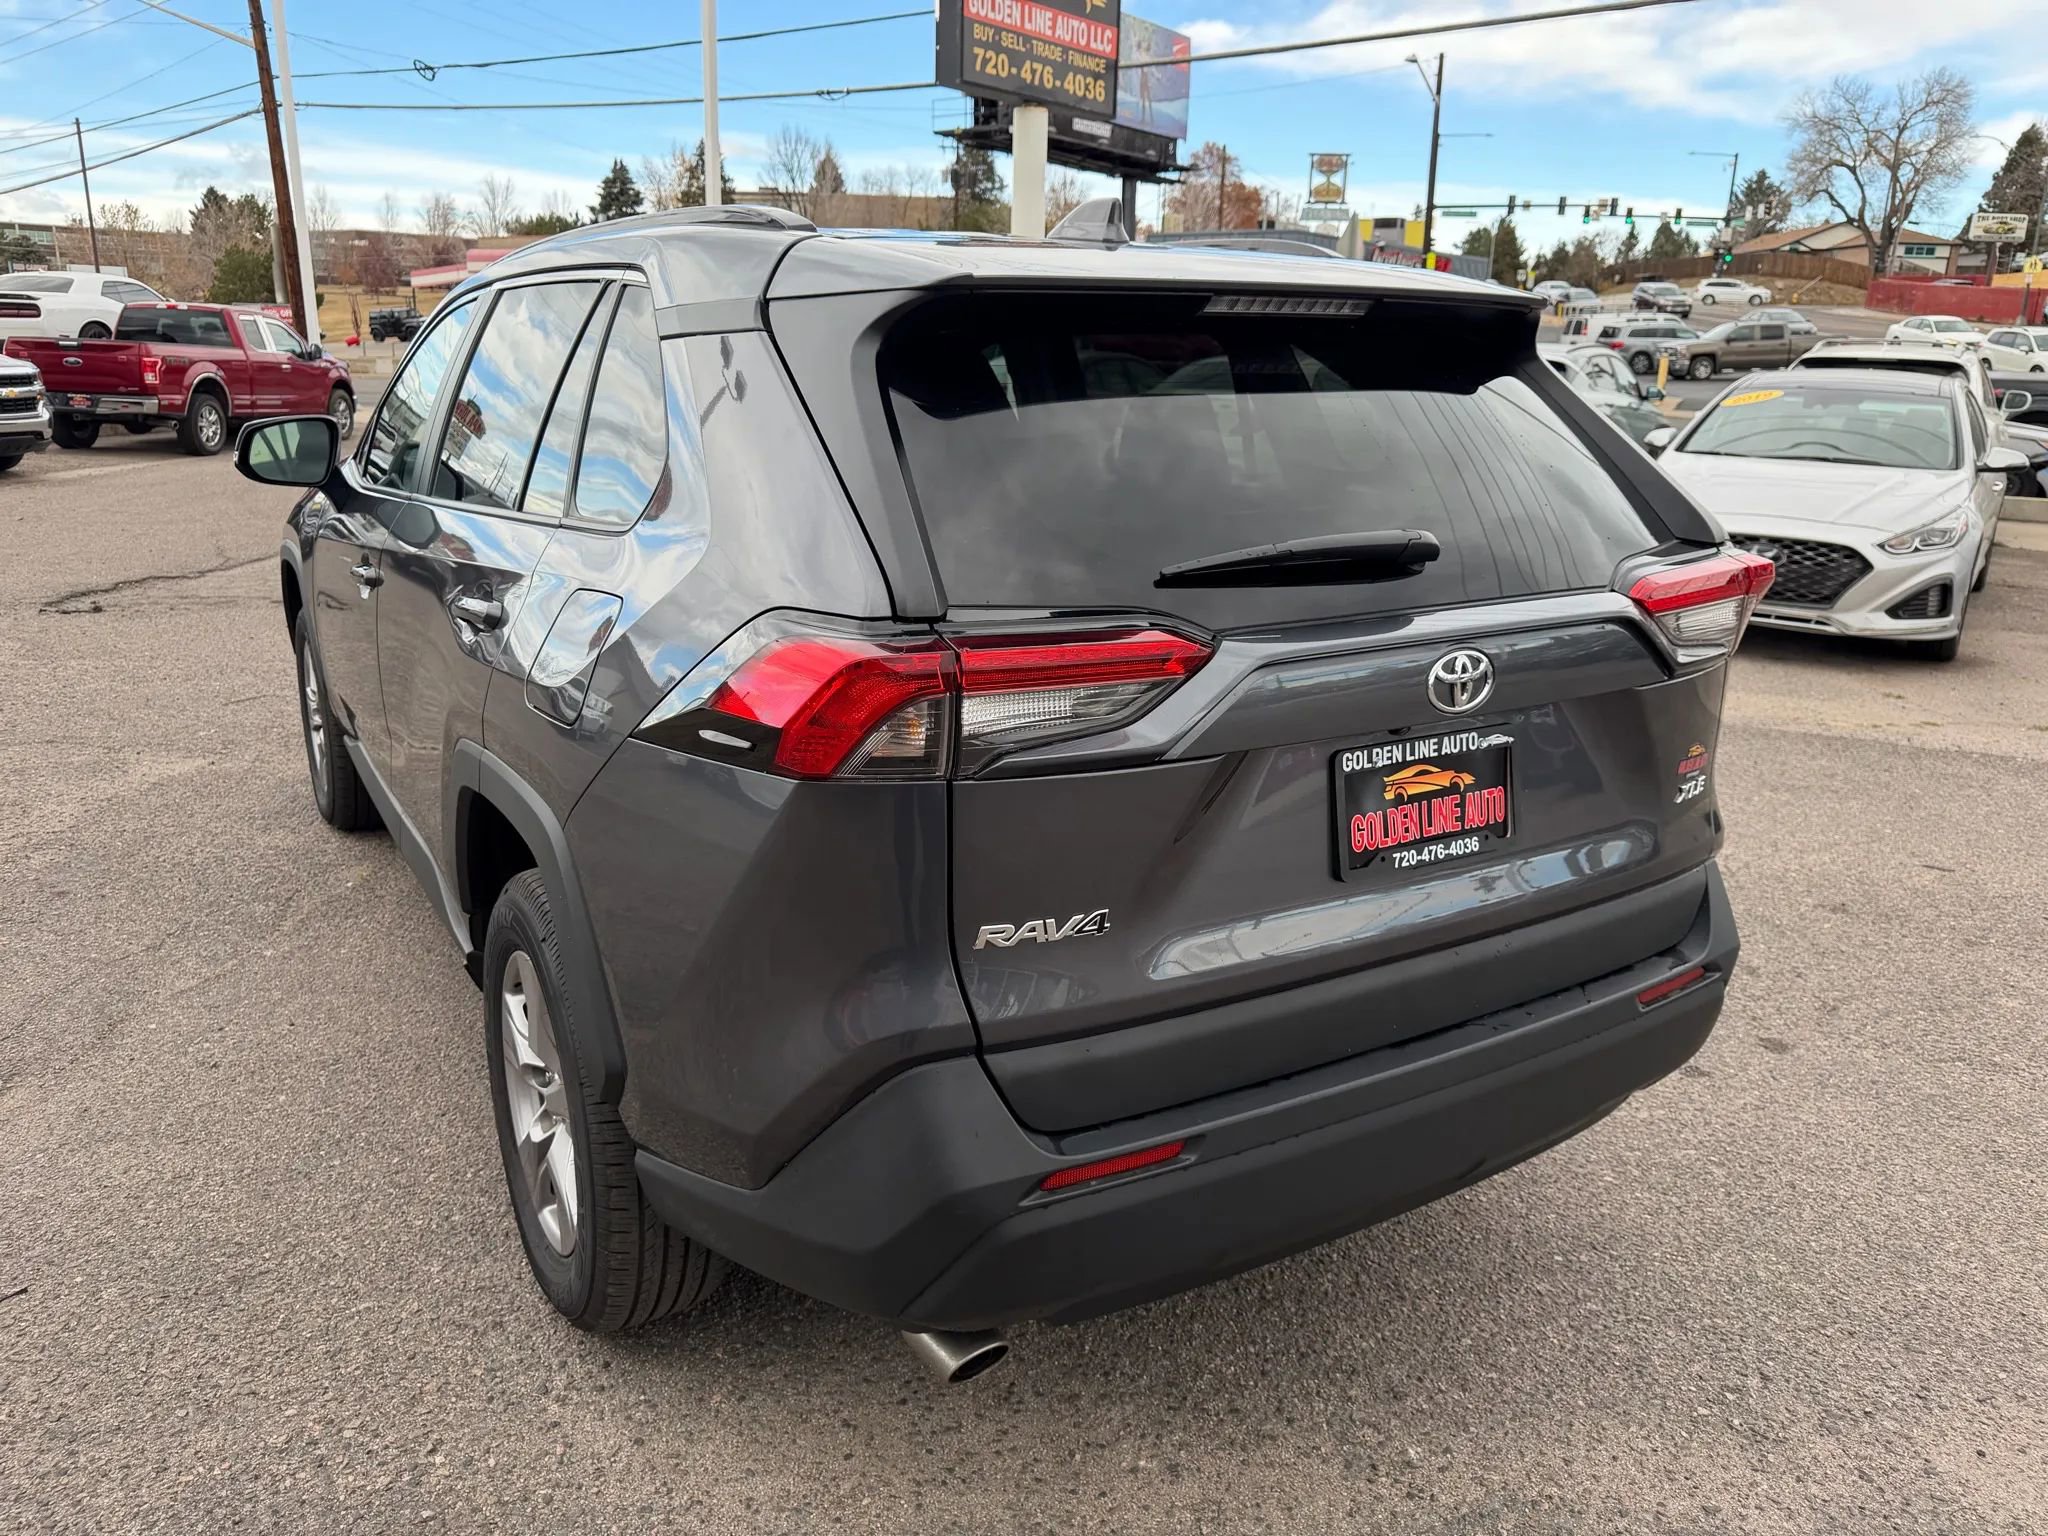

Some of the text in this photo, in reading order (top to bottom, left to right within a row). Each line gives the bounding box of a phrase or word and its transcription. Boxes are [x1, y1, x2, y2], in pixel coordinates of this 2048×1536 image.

[968, 0, 1113, 53] GOLDEN LINE AUTO LLC
[973, 23, 1107, 74] BUY SELL TRADE FINANCE
[1342, 731, 1478, 772] GOLDEN LINE AUTO
[1351, 785, 1505, 853] GOLDEN LINE AUTO
[1393, 836, 1480, 868] 720-476-4036
[972, 909, 1111, 950] RAV4
